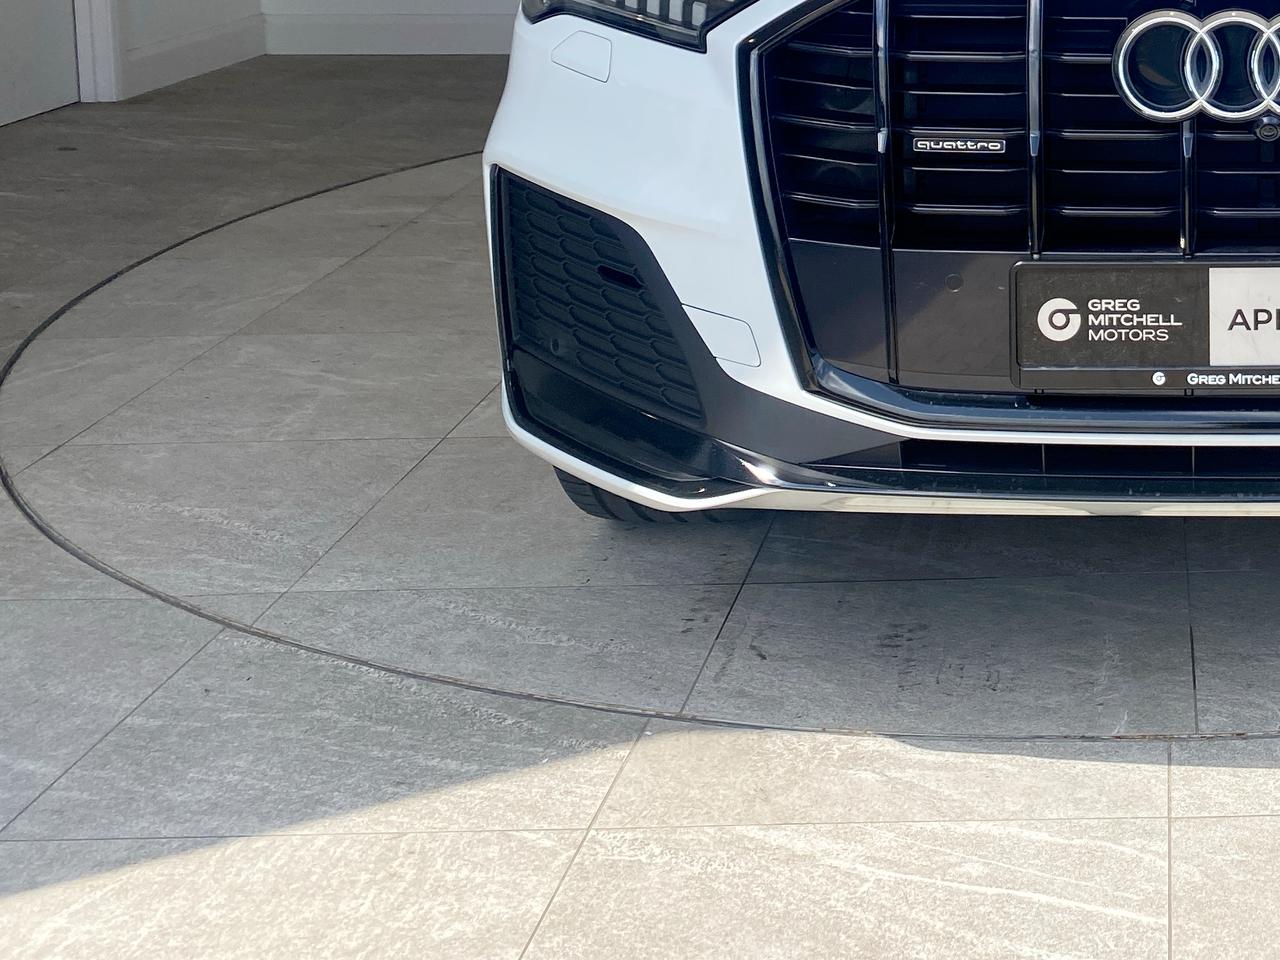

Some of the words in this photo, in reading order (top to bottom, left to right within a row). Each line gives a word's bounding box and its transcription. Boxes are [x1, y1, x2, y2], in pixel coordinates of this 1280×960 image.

[917, 140, 1001, 150] quattro
[1087, 298, 1141, 312] GREG
[1088, 313, 1183, 326] MITCHELL
[1088, 329, 1169, 342] MOTORS
[1186, 372, 1227, 385] GREG
